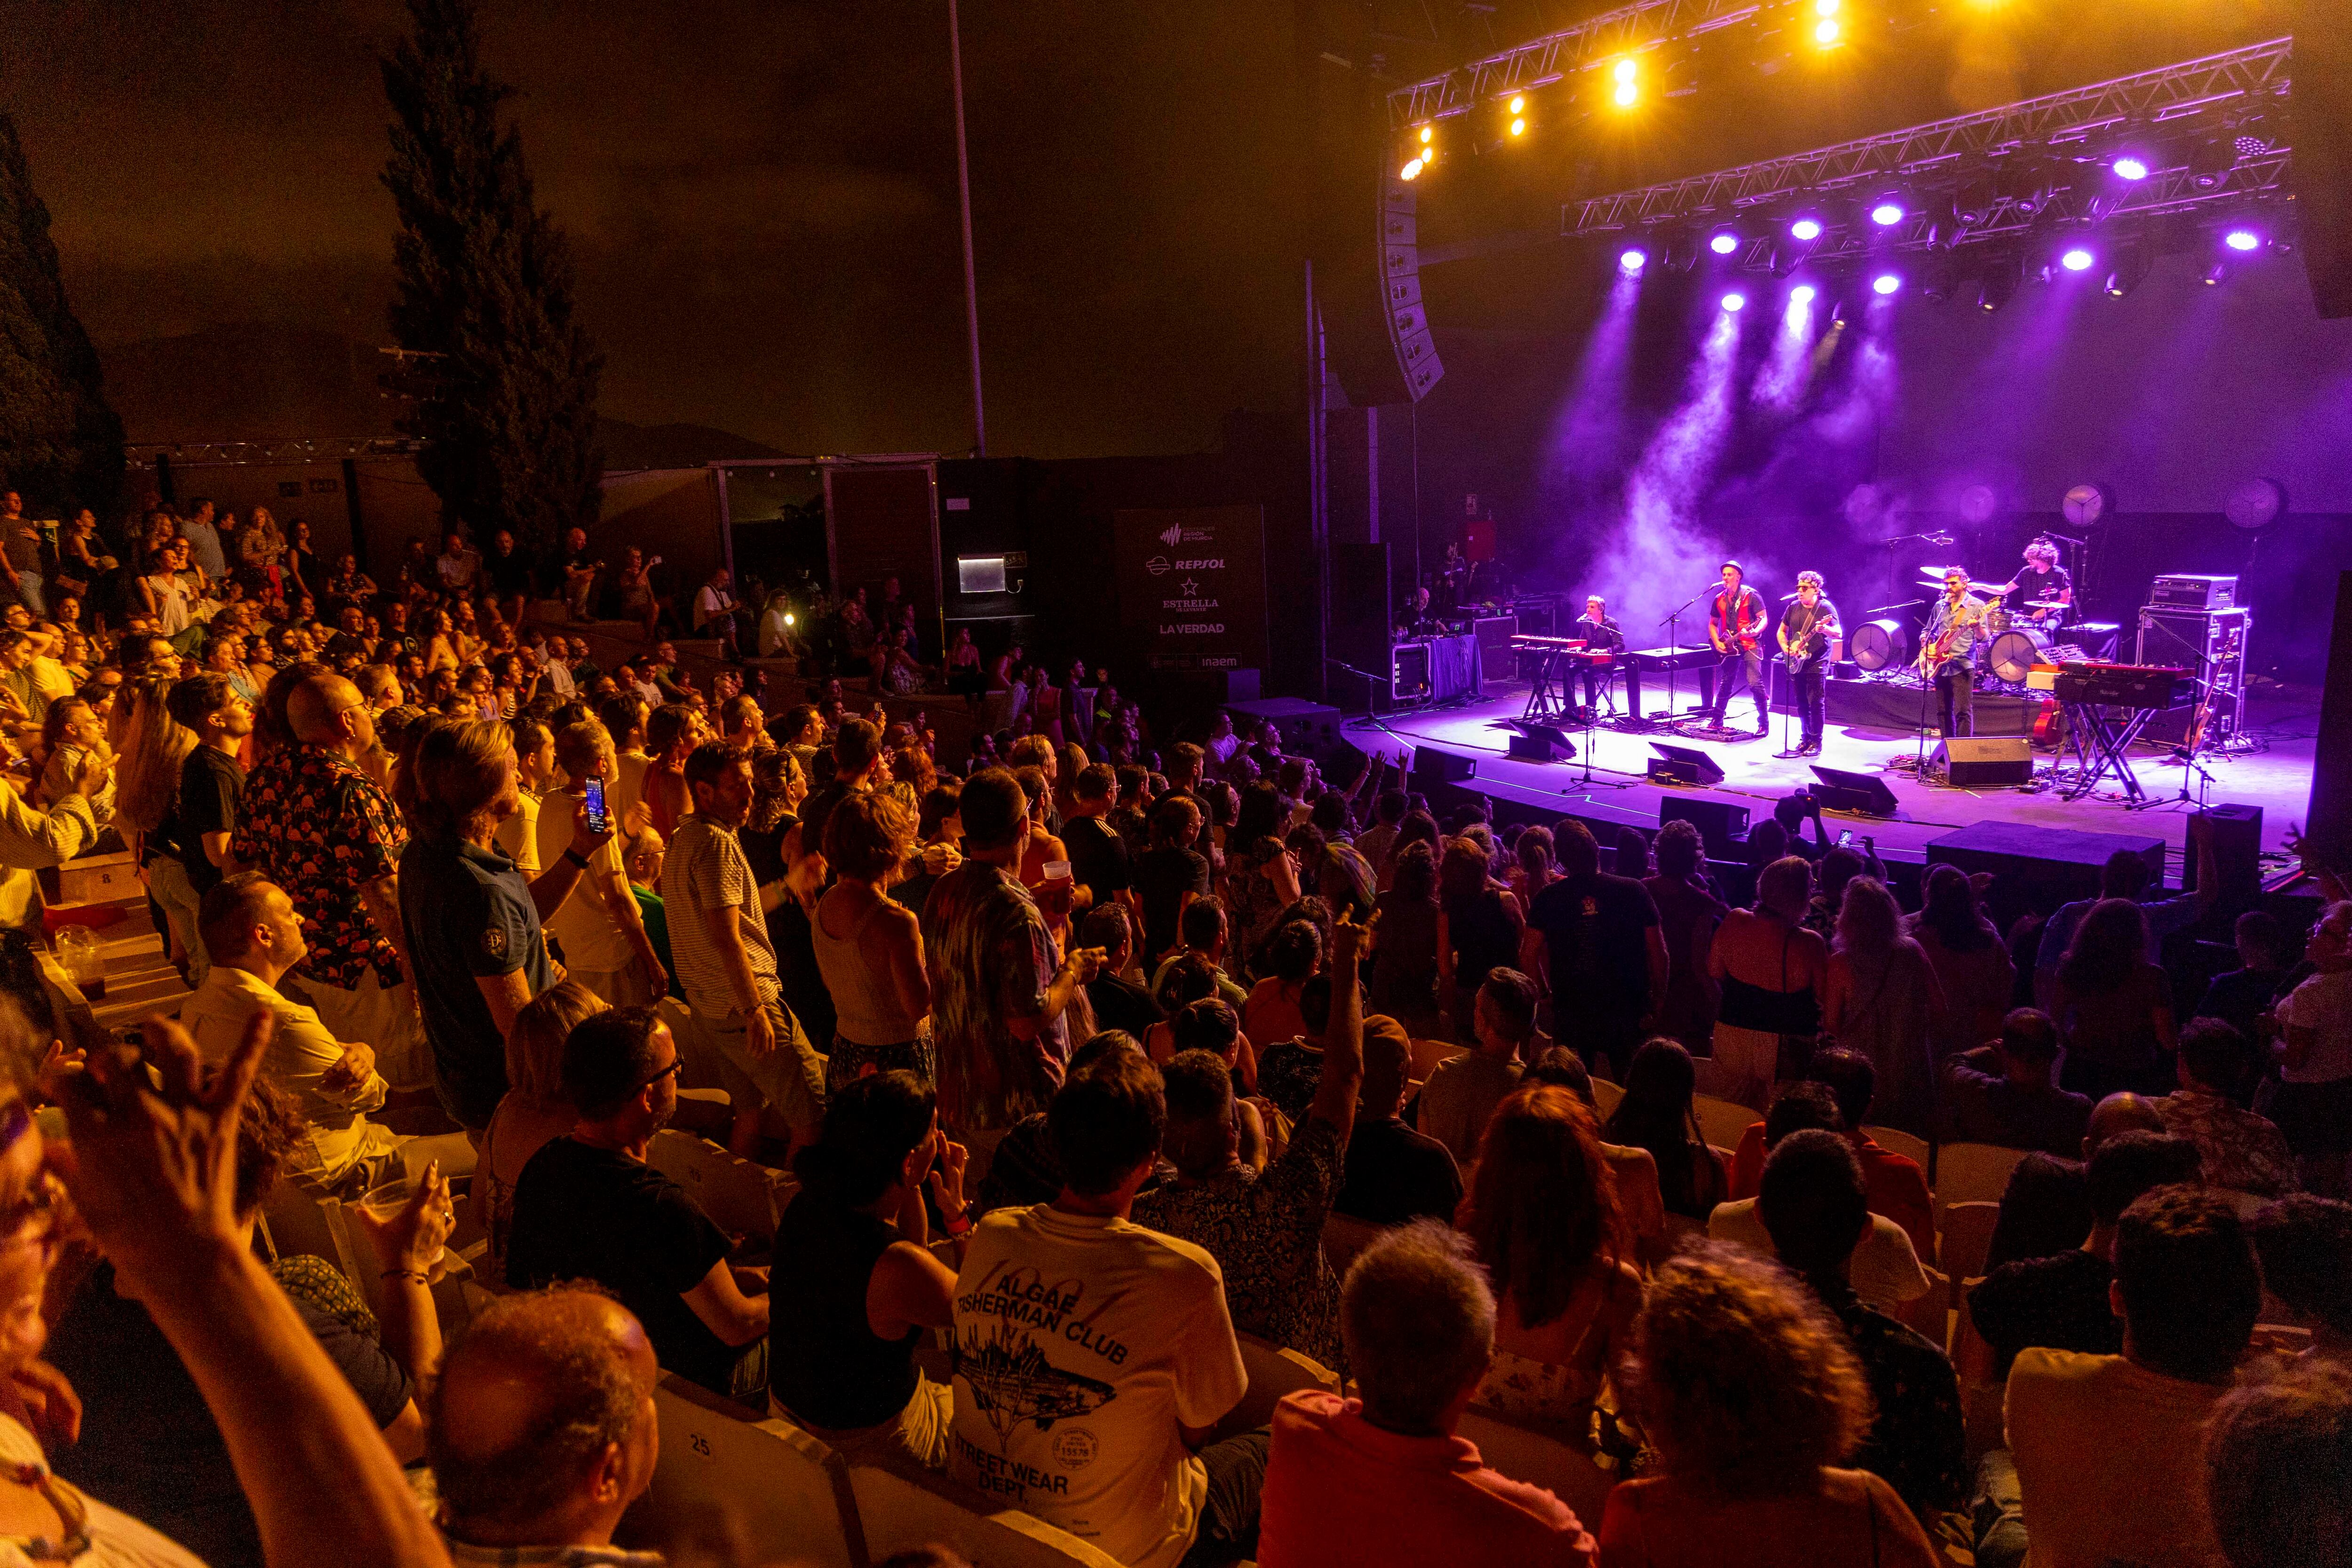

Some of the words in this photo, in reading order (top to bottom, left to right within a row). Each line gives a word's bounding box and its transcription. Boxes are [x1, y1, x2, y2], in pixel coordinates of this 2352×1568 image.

[1175, 559, 1225, 570] REPSOL
[1163, 599, 1219, 608] ESTRELLA
[1160, 625, 1175, 634] LA
[1176, 624, 1225, 634] VERDAD
[996, 1274, 1079, 1314] ALGAE
[1065, 1321, 1128, 1365] CLUB
[691, 1434, 710, 1456] 25
[978, 1469, 1029, 1504] DEPT.
